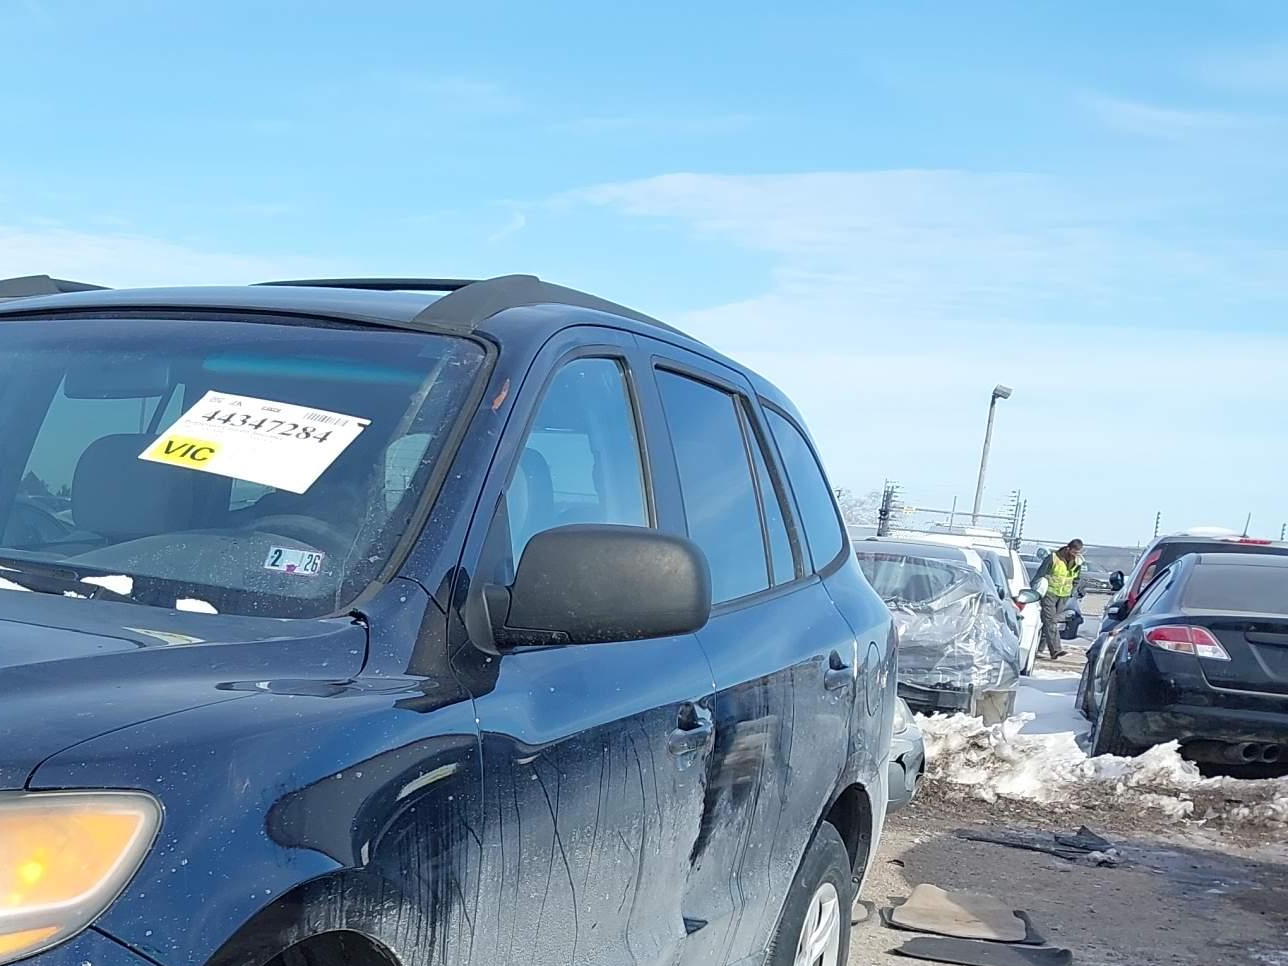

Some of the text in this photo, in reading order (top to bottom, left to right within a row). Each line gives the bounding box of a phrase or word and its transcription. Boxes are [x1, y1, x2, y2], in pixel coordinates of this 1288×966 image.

[202, 410, 333, 443] 44347284
[164, 440, 216, 462] VIC
[270, 549, 321, 572] 2 26
